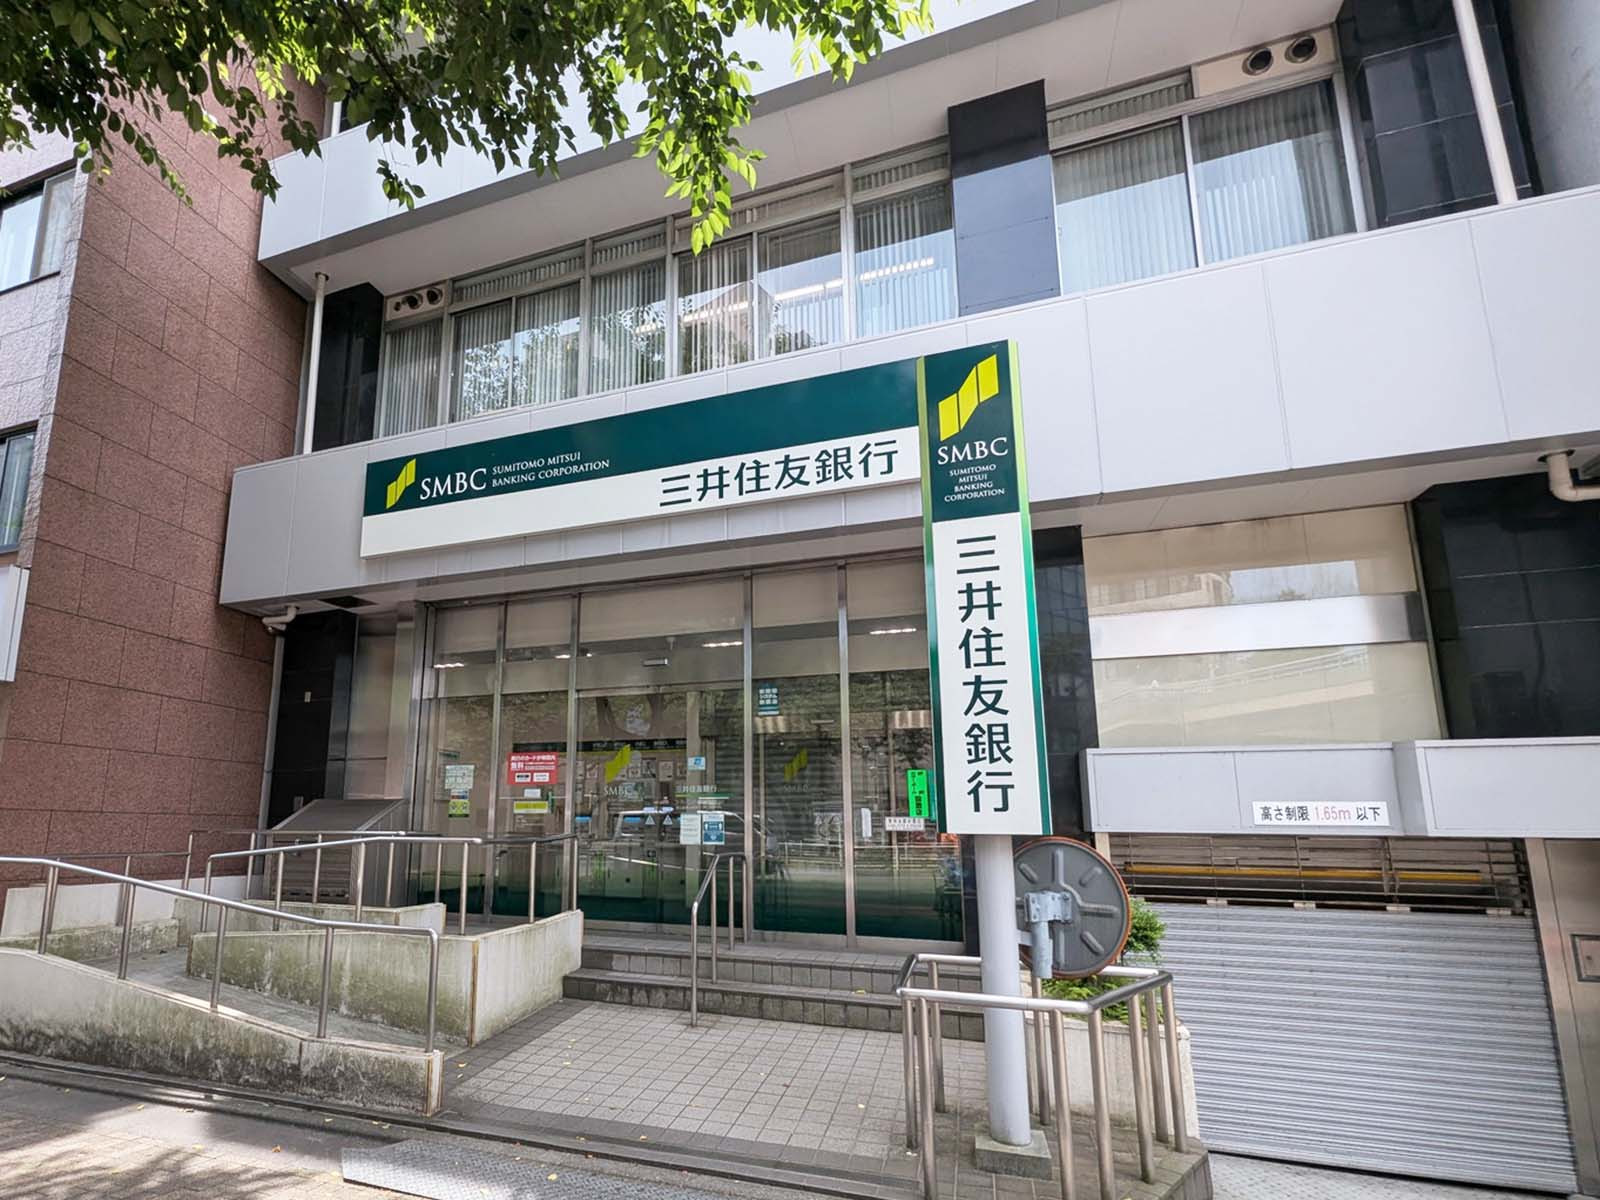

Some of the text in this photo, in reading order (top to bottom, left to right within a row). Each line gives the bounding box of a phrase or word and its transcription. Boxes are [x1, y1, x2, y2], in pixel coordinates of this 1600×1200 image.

[937, 436, 1009, 465] SMBC
[491, 451, 581, 474] SUMITOMO MITSUI
[491, 459, 610, 487] BANKING CORPORATION
[659, 439, 898, 507] 三井住友銀行
[949, 464, 997, 477] SUMITOMO
[419, 467, 487, 501] SMBC
[954, 481, 993, 493] BANKING
[958, 473, 988, 484] MITSUI
[944, 488, 1005, 502] CORPORATION
[956, 535, 1015, 813] 三井住友銀行
[1260, 806, 1381, 821] 高さ制限 1.65m 以下
